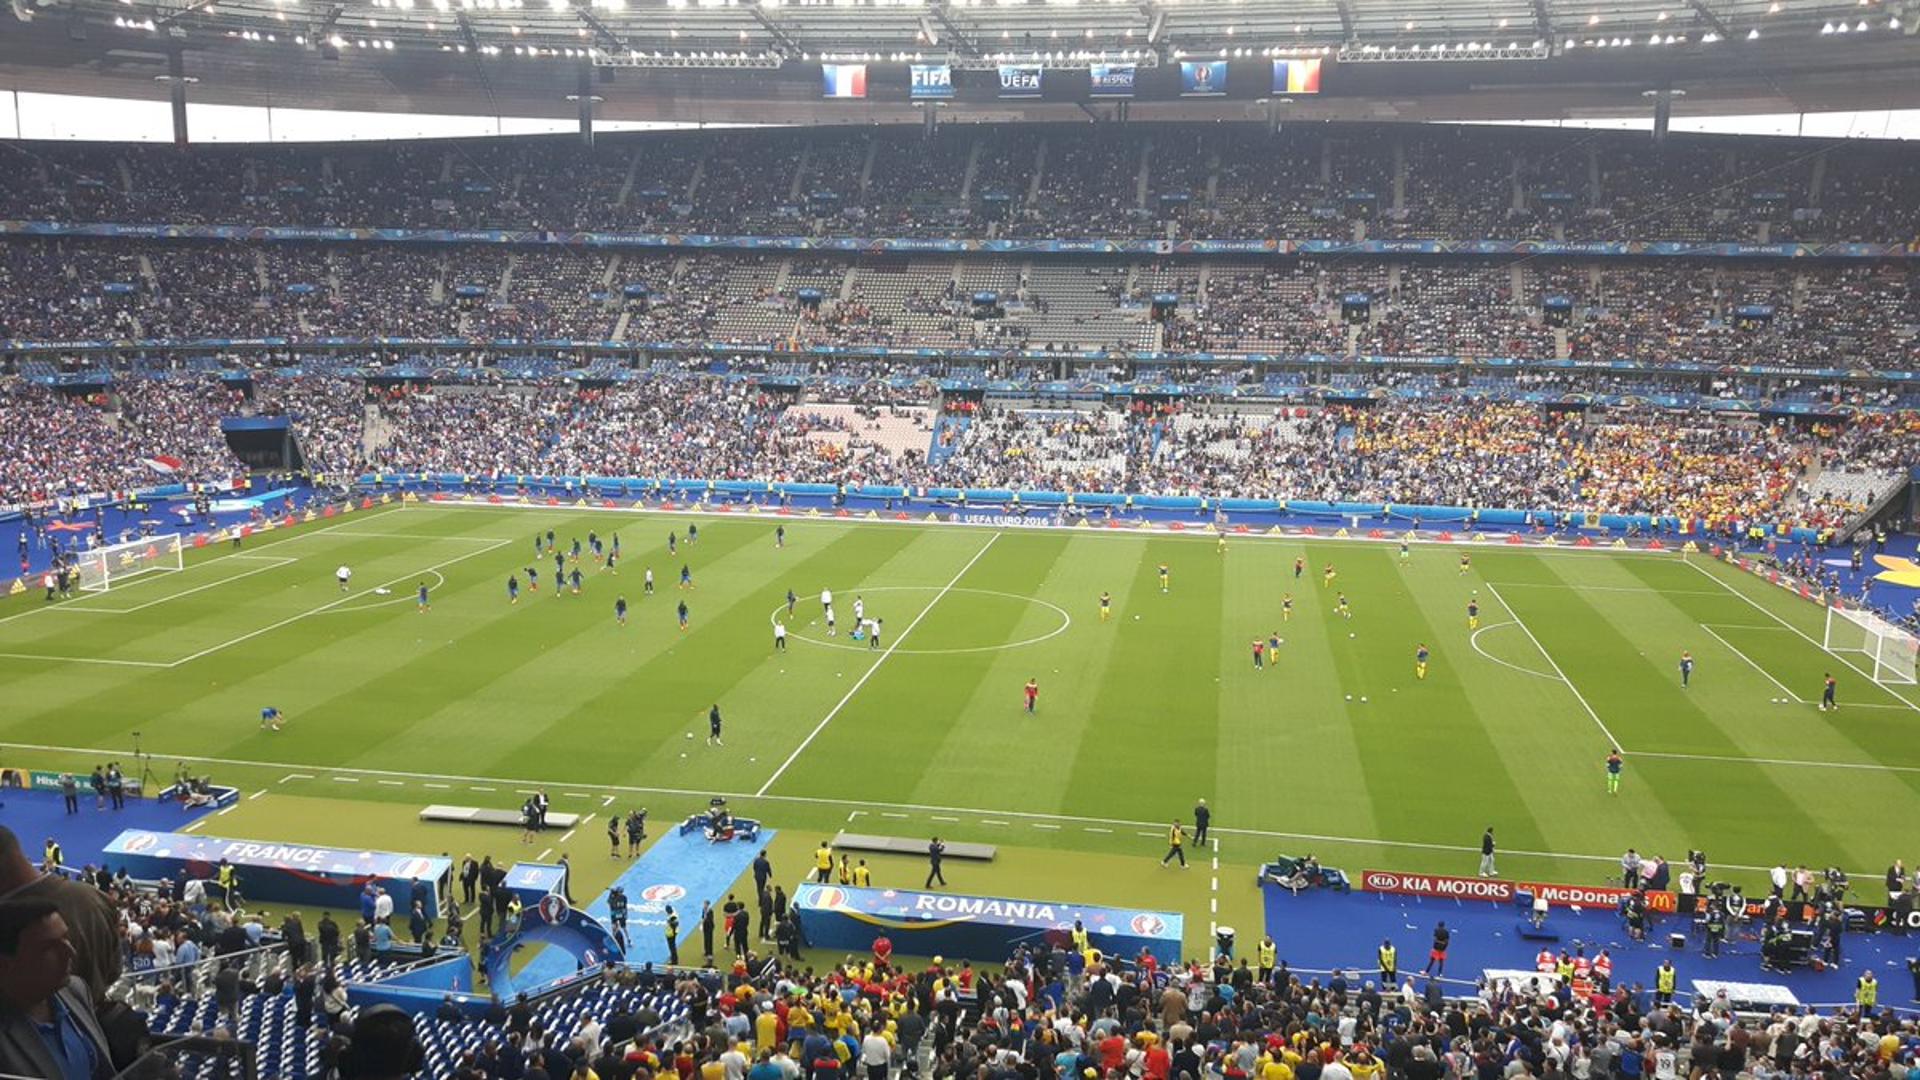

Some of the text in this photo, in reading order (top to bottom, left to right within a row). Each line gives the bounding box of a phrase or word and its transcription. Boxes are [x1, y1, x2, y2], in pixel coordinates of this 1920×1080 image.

[911, 69, 951, 86] FIFA
[1001, 75, 1039, 88] UEFA
[964, 514, 1049, 526] UEFA EURO 2016
[221, 841, 329, 865] FRANCE
[1402, 877, 1510, 898] KIA MOTORS
[1542, 887, 1649, 907] McDonas
[916, 894, 1055, 921] ROMANIA
